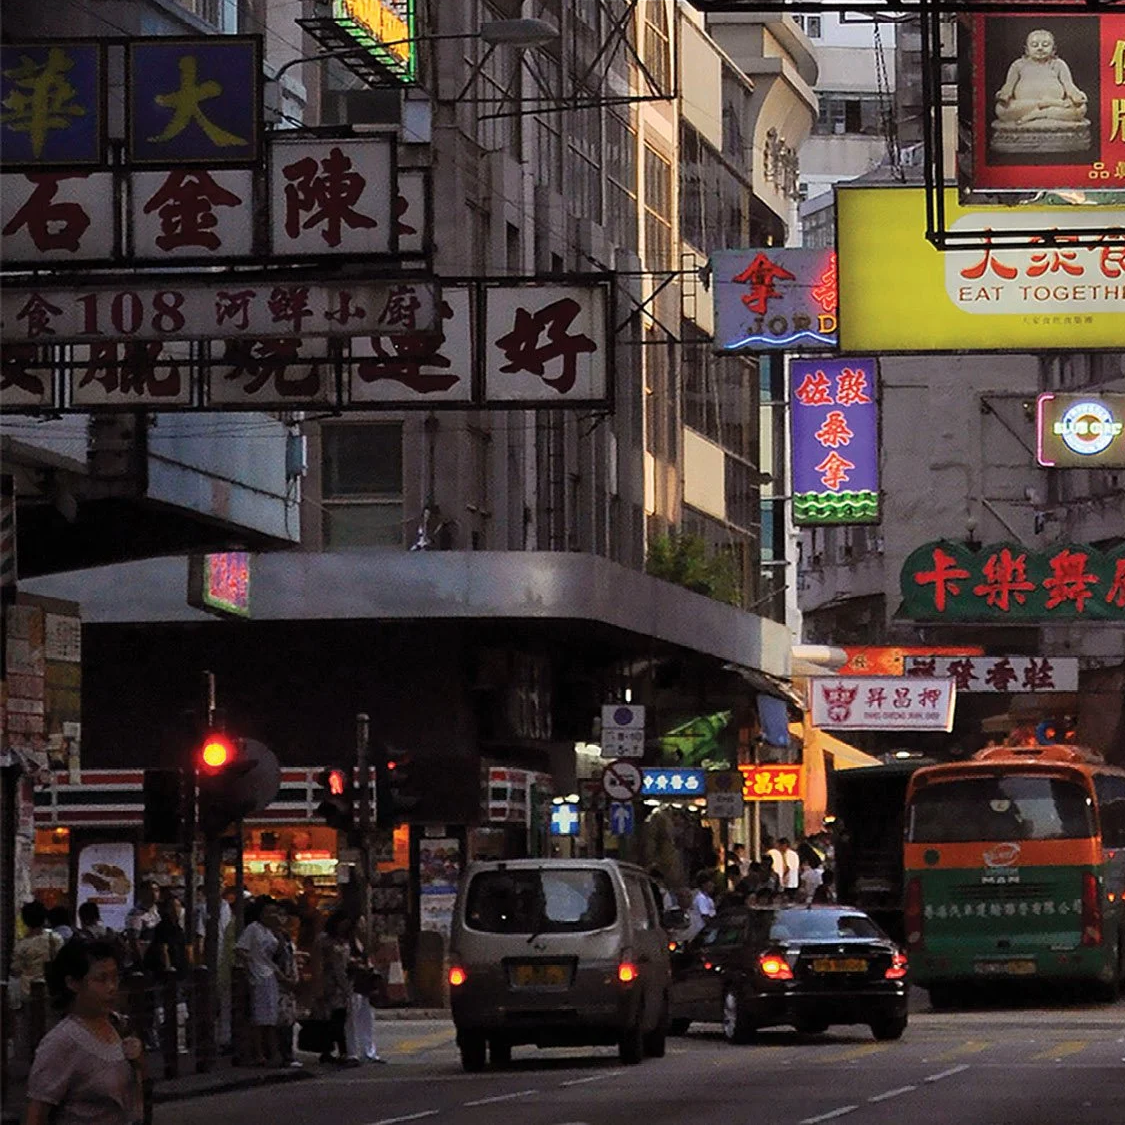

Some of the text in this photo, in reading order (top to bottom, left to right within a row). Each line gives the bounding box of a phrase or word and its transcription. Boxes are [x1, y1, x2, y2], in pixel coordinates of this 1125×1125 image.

[959, 286, 1005, 302] EAT
[795, 368, 872, 406] 佐敦
[815, 410, 856, 491] 桑拿
